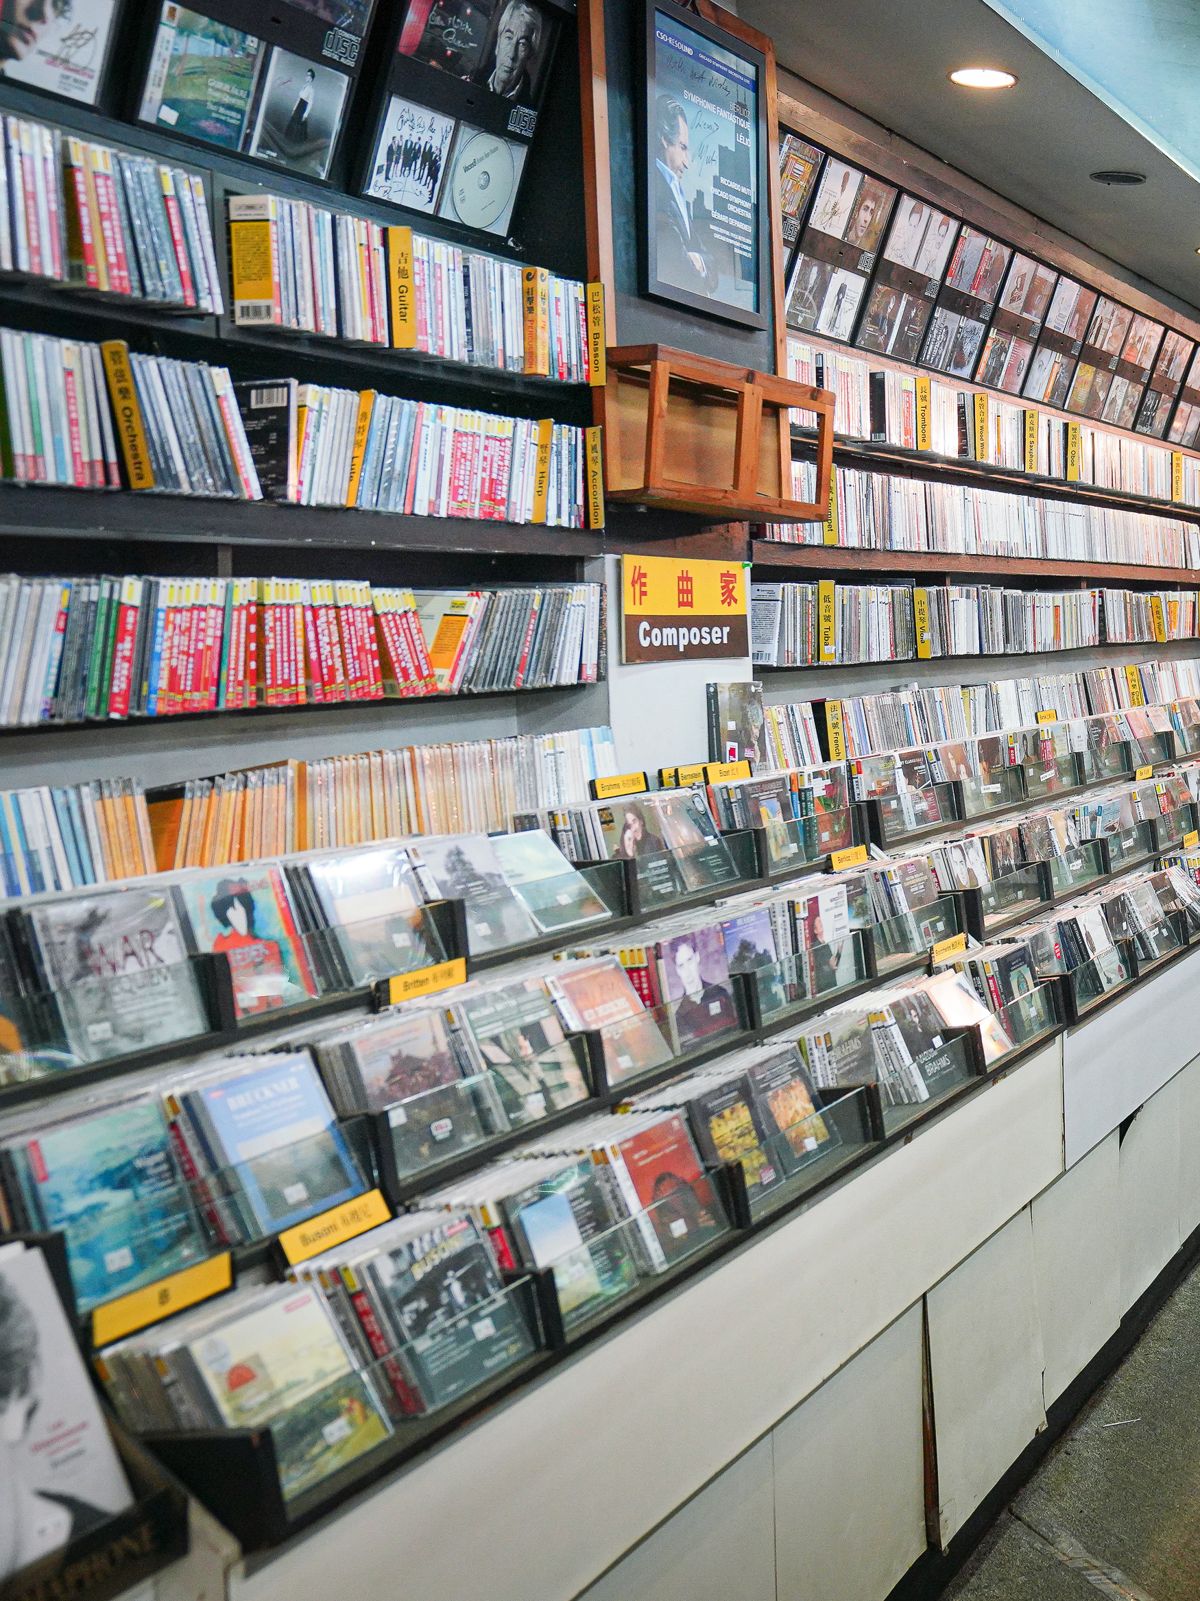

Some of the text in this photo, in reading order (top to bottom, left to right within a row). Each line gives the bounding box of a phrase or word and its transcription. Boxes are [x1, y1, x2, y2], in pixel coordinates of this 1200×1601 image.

[683, 90, 752, 131] SYMPHONIE FANTASTIQUE
[397, 251, 409, 324] 吉他 Guitar
[592, 332, 601, 373] Basson
[121, 406, 146, 483] Orchestra
[920, 405, 928, 444] Trombone
[535, 470, 547, 497] Harp
[591, 470, 600, 525] Accordion
[631, 565, 738, 609] 作曲家
[823, 594, 832, 647] 低音號 Tuba
[917, 600, 926, 625] 中提琴
[639, 621, 730, 652] Composer
[832, 732, 841, 757] French
[84, 929, 165, 976] WAR
[402, 976, 430, 993] Britten
[924, 1054, 952, 1077] BRAHMS
